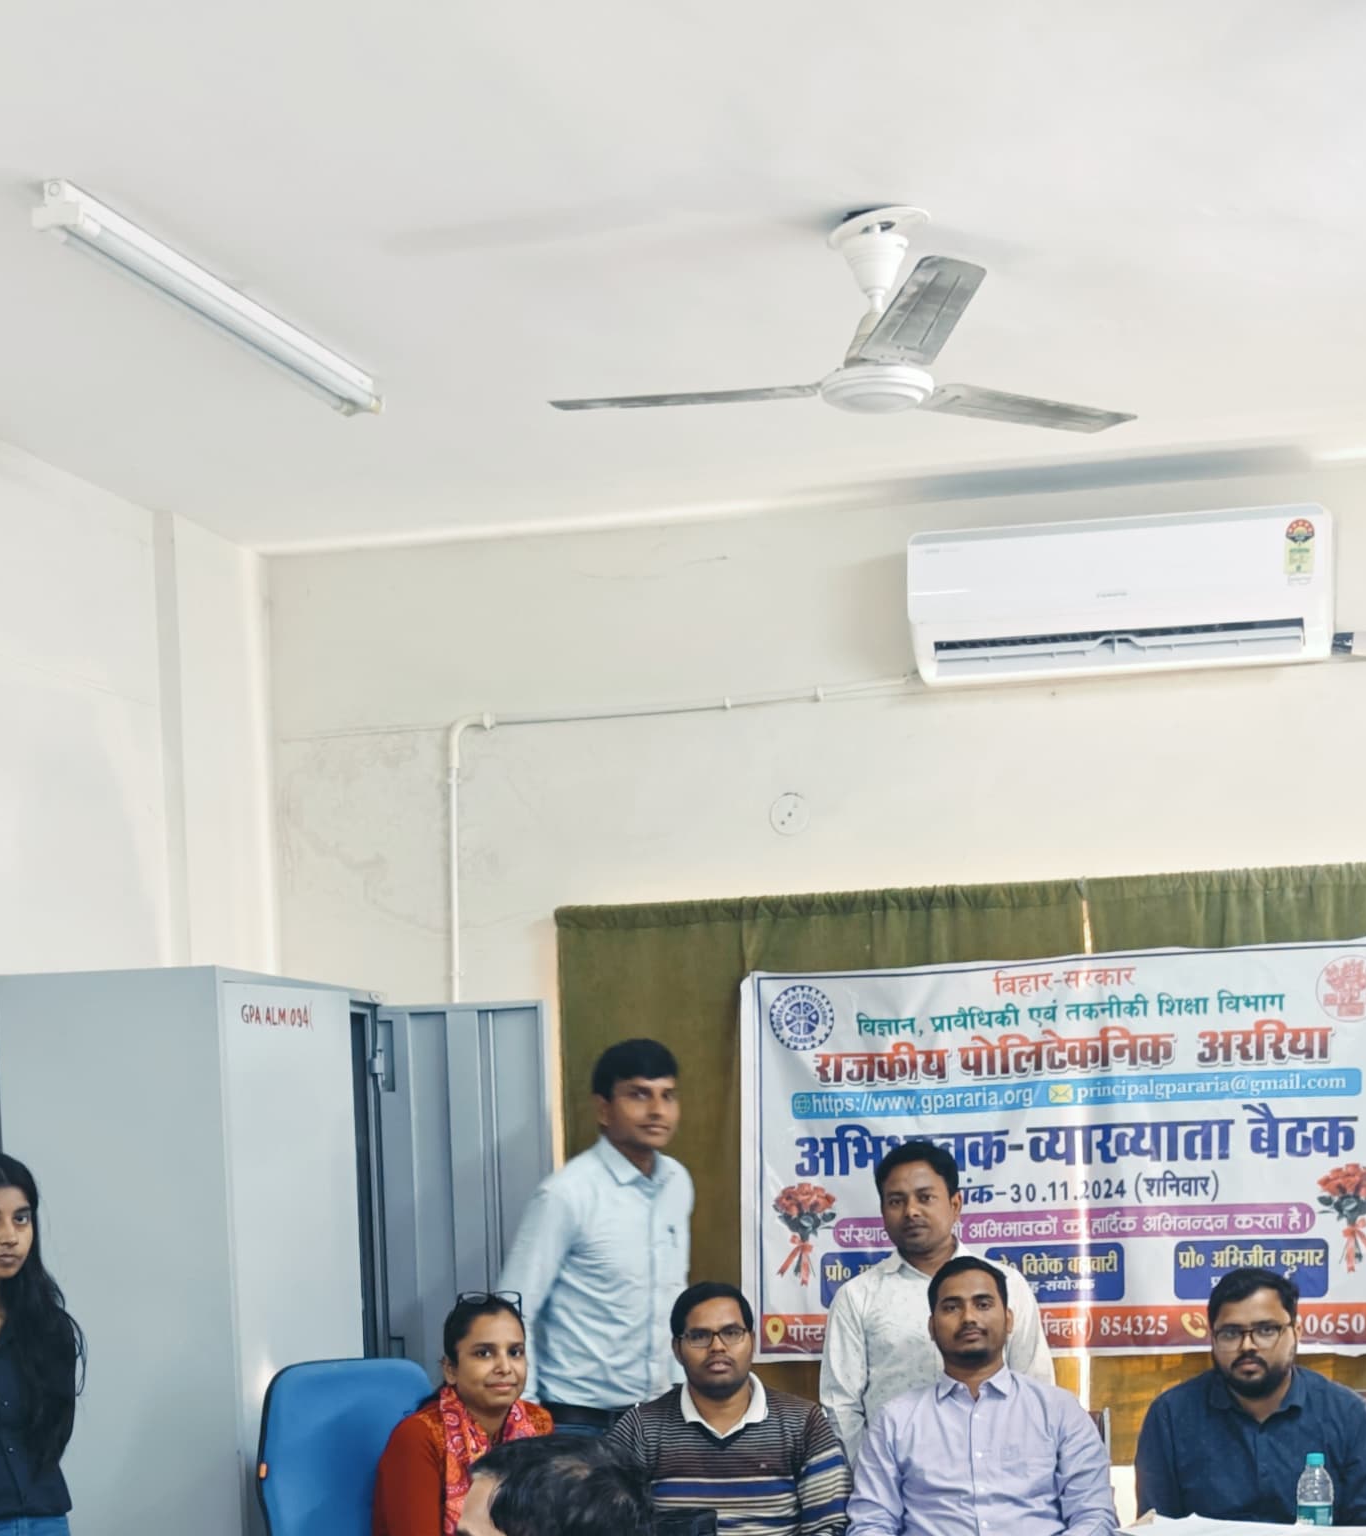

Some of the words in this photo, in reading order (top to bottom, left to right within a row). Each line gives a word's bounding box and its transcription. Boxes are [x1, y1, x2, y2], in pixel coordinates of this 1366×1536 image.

[993, 966, 1137, 997] बिहार-सरकार
[1028, 999, 1058, 1029] एवं
[1065, 993, 1149, 1022] तकनीकी
[1156, 991, 1209, 1018] शिक्षा
[1217, 989, 1286, 1015] विभाग
[814, 1041, 950, 1087] राजकीय
[958, 1025, 1177, 1078] पोलिटेकनिक
[1197, 1018, 1335, 1067] अररिया
[1077, 1073, 1347, 1103] principalgpararia@gmail.com
[795, 1118, 1235, 1178] अभिवक-व्याख्याता
[1242, 1103, 1359, 1160] बैठक
[1135, 1169, 1219, 1203] (शनिवार)
[969, 1214, 1058, 1240] अभिभावकों
[1091, 1211, 1138, 1236] हार्दिक
[1142, 1211, 1229, 1235] अभिनन्दन
[1233, 1210, 1284, 1231] करता
[1022, 1252, 1065, 1276] विवेक
[1210, 1243, 1277, 1269] अभिजीत
[1280, 1248, 1325, 1274] कुमार
[1099, 1314, 1169, 1337] 854325
